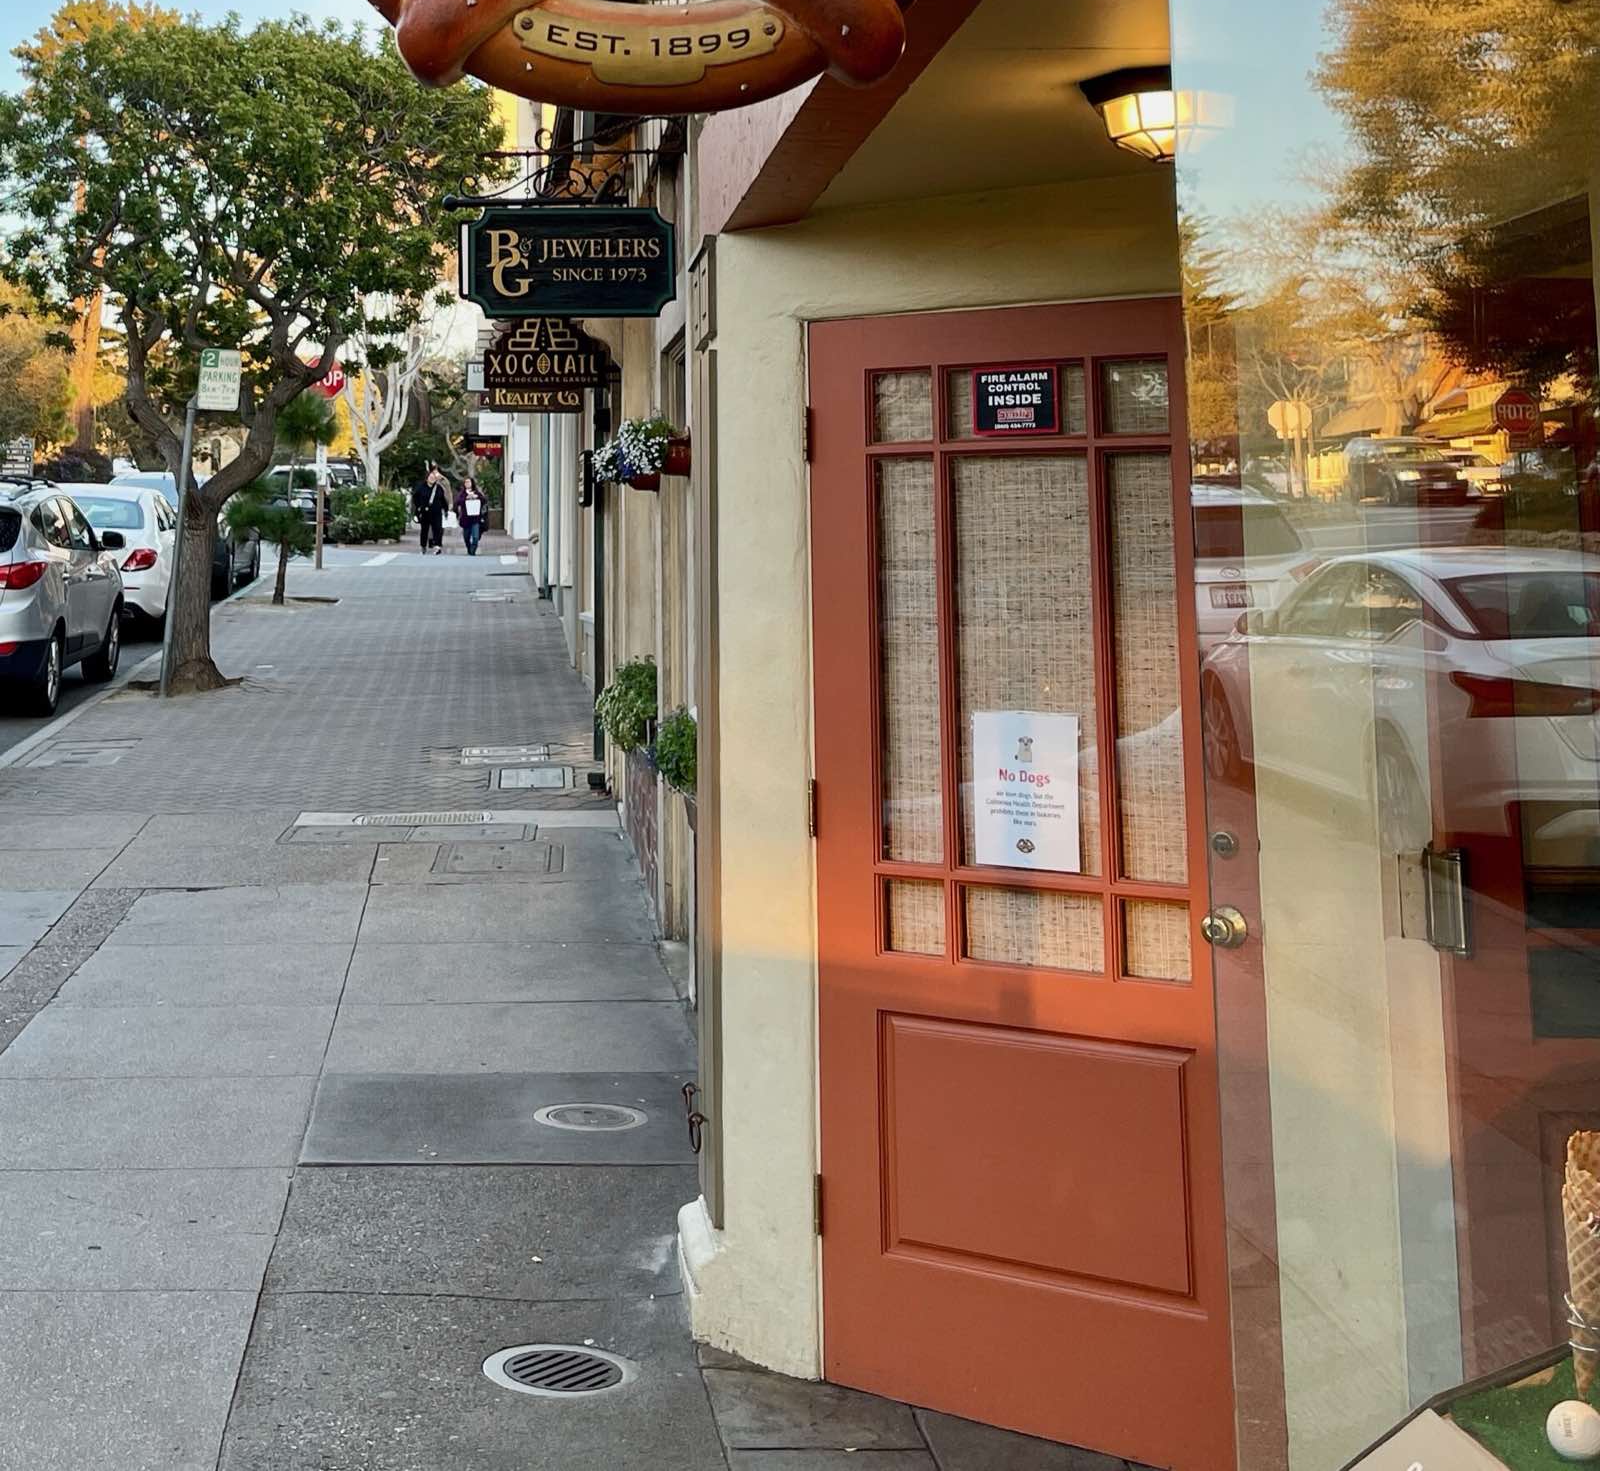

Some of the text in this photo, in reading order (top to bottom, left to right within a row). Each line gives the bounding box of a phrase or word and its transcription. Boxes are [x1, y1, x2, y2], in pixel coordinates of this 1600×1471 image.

[547, 23, 750, 56] EST. 1899
[538, 237, 660, 263] JEWELERS
[552, 267, 648, 282] SINCE 1973
[205, 352, 216, 366] 2
[202, 371, 238, 384] PARKING
[980, 372, 1048, 383] FIRE ALARM
[987, 382, 1041, 392] CONTROL
[987, 394, 1042, 406] INSIDE
[998, 768, 1050, 788] No Dogs
